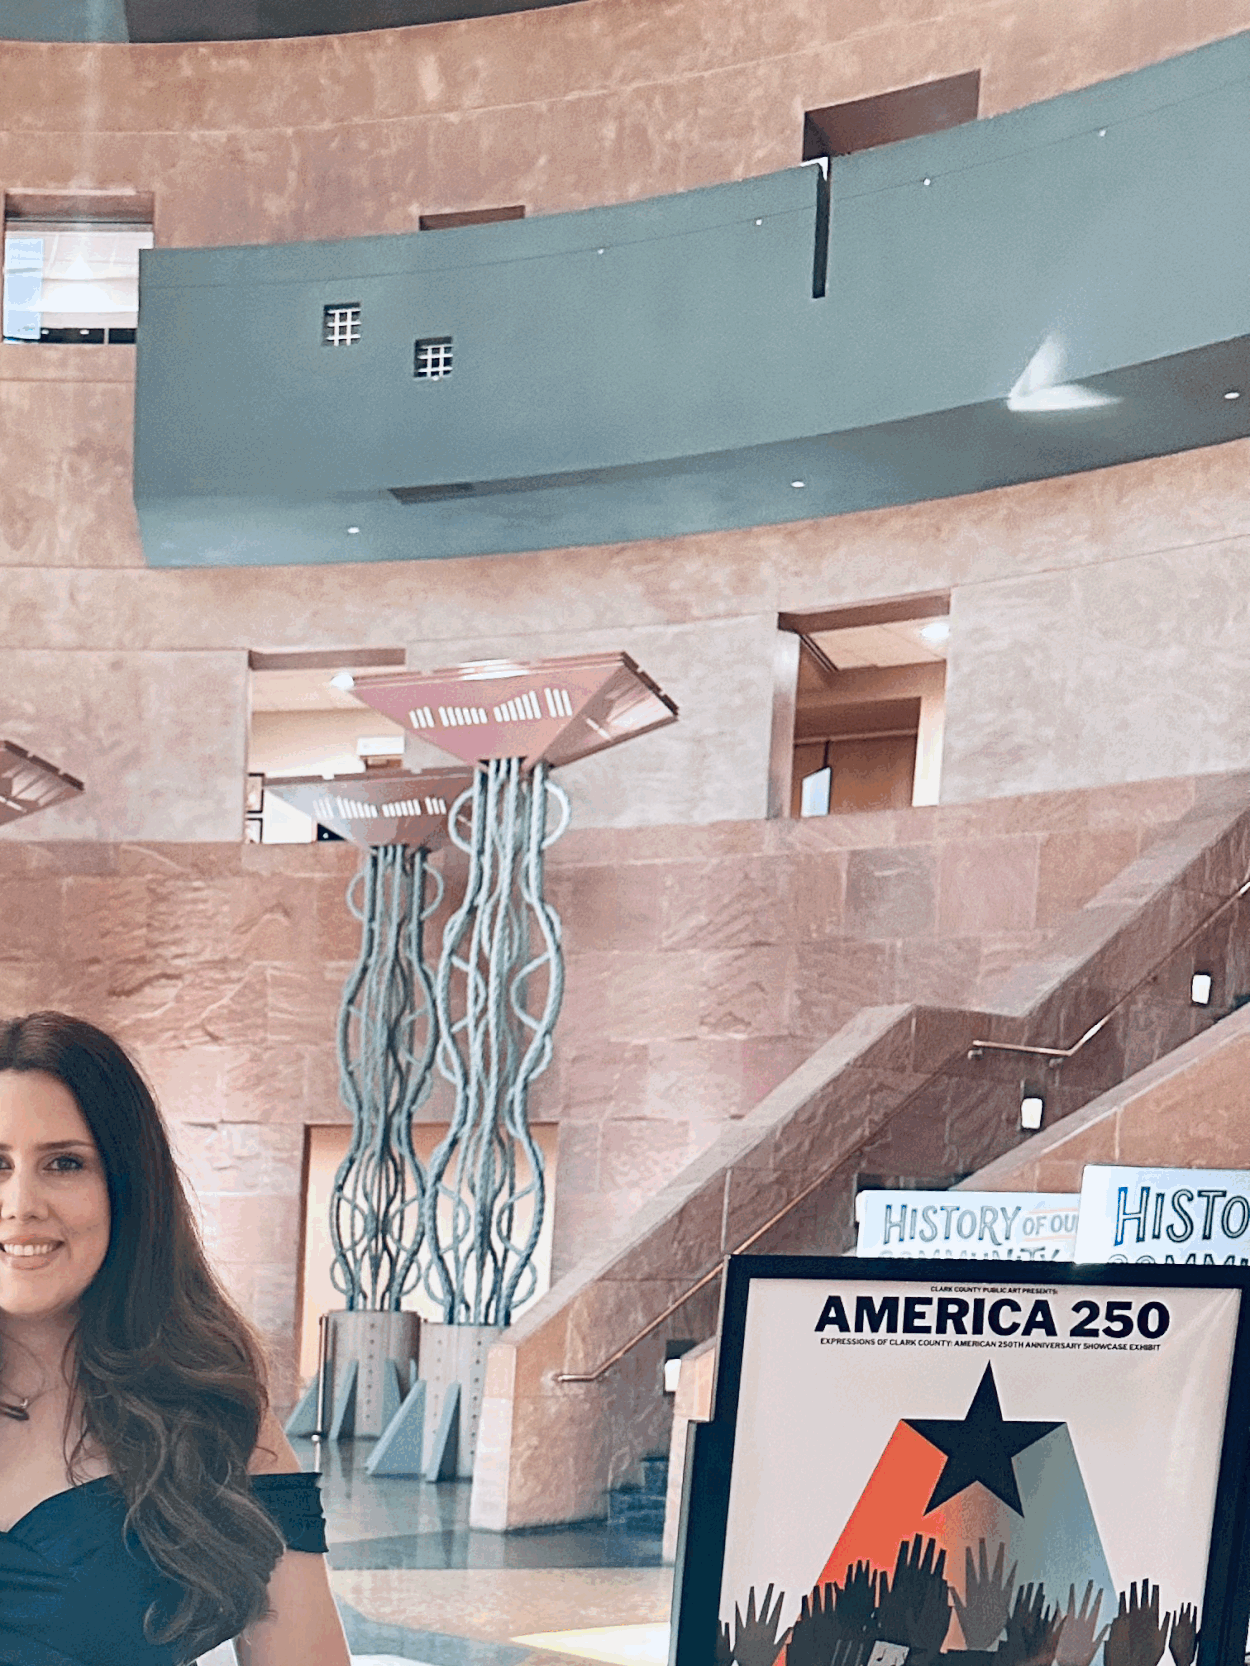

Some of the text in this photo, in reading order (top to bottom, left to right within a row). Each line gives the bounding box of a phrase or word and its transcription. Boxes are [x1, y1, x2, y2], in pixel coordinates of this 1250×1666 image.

[883, 1204, 1022, 1246] HISTORY
[1022, 1215, 1047, 1236] OF
[814, 1295, 1170, 1339] AMERICA 250
[820, 1337, 875, 1345] EXPRESSIONS
[1025, 1341, 1082, 1349] ANNIVERSARY
